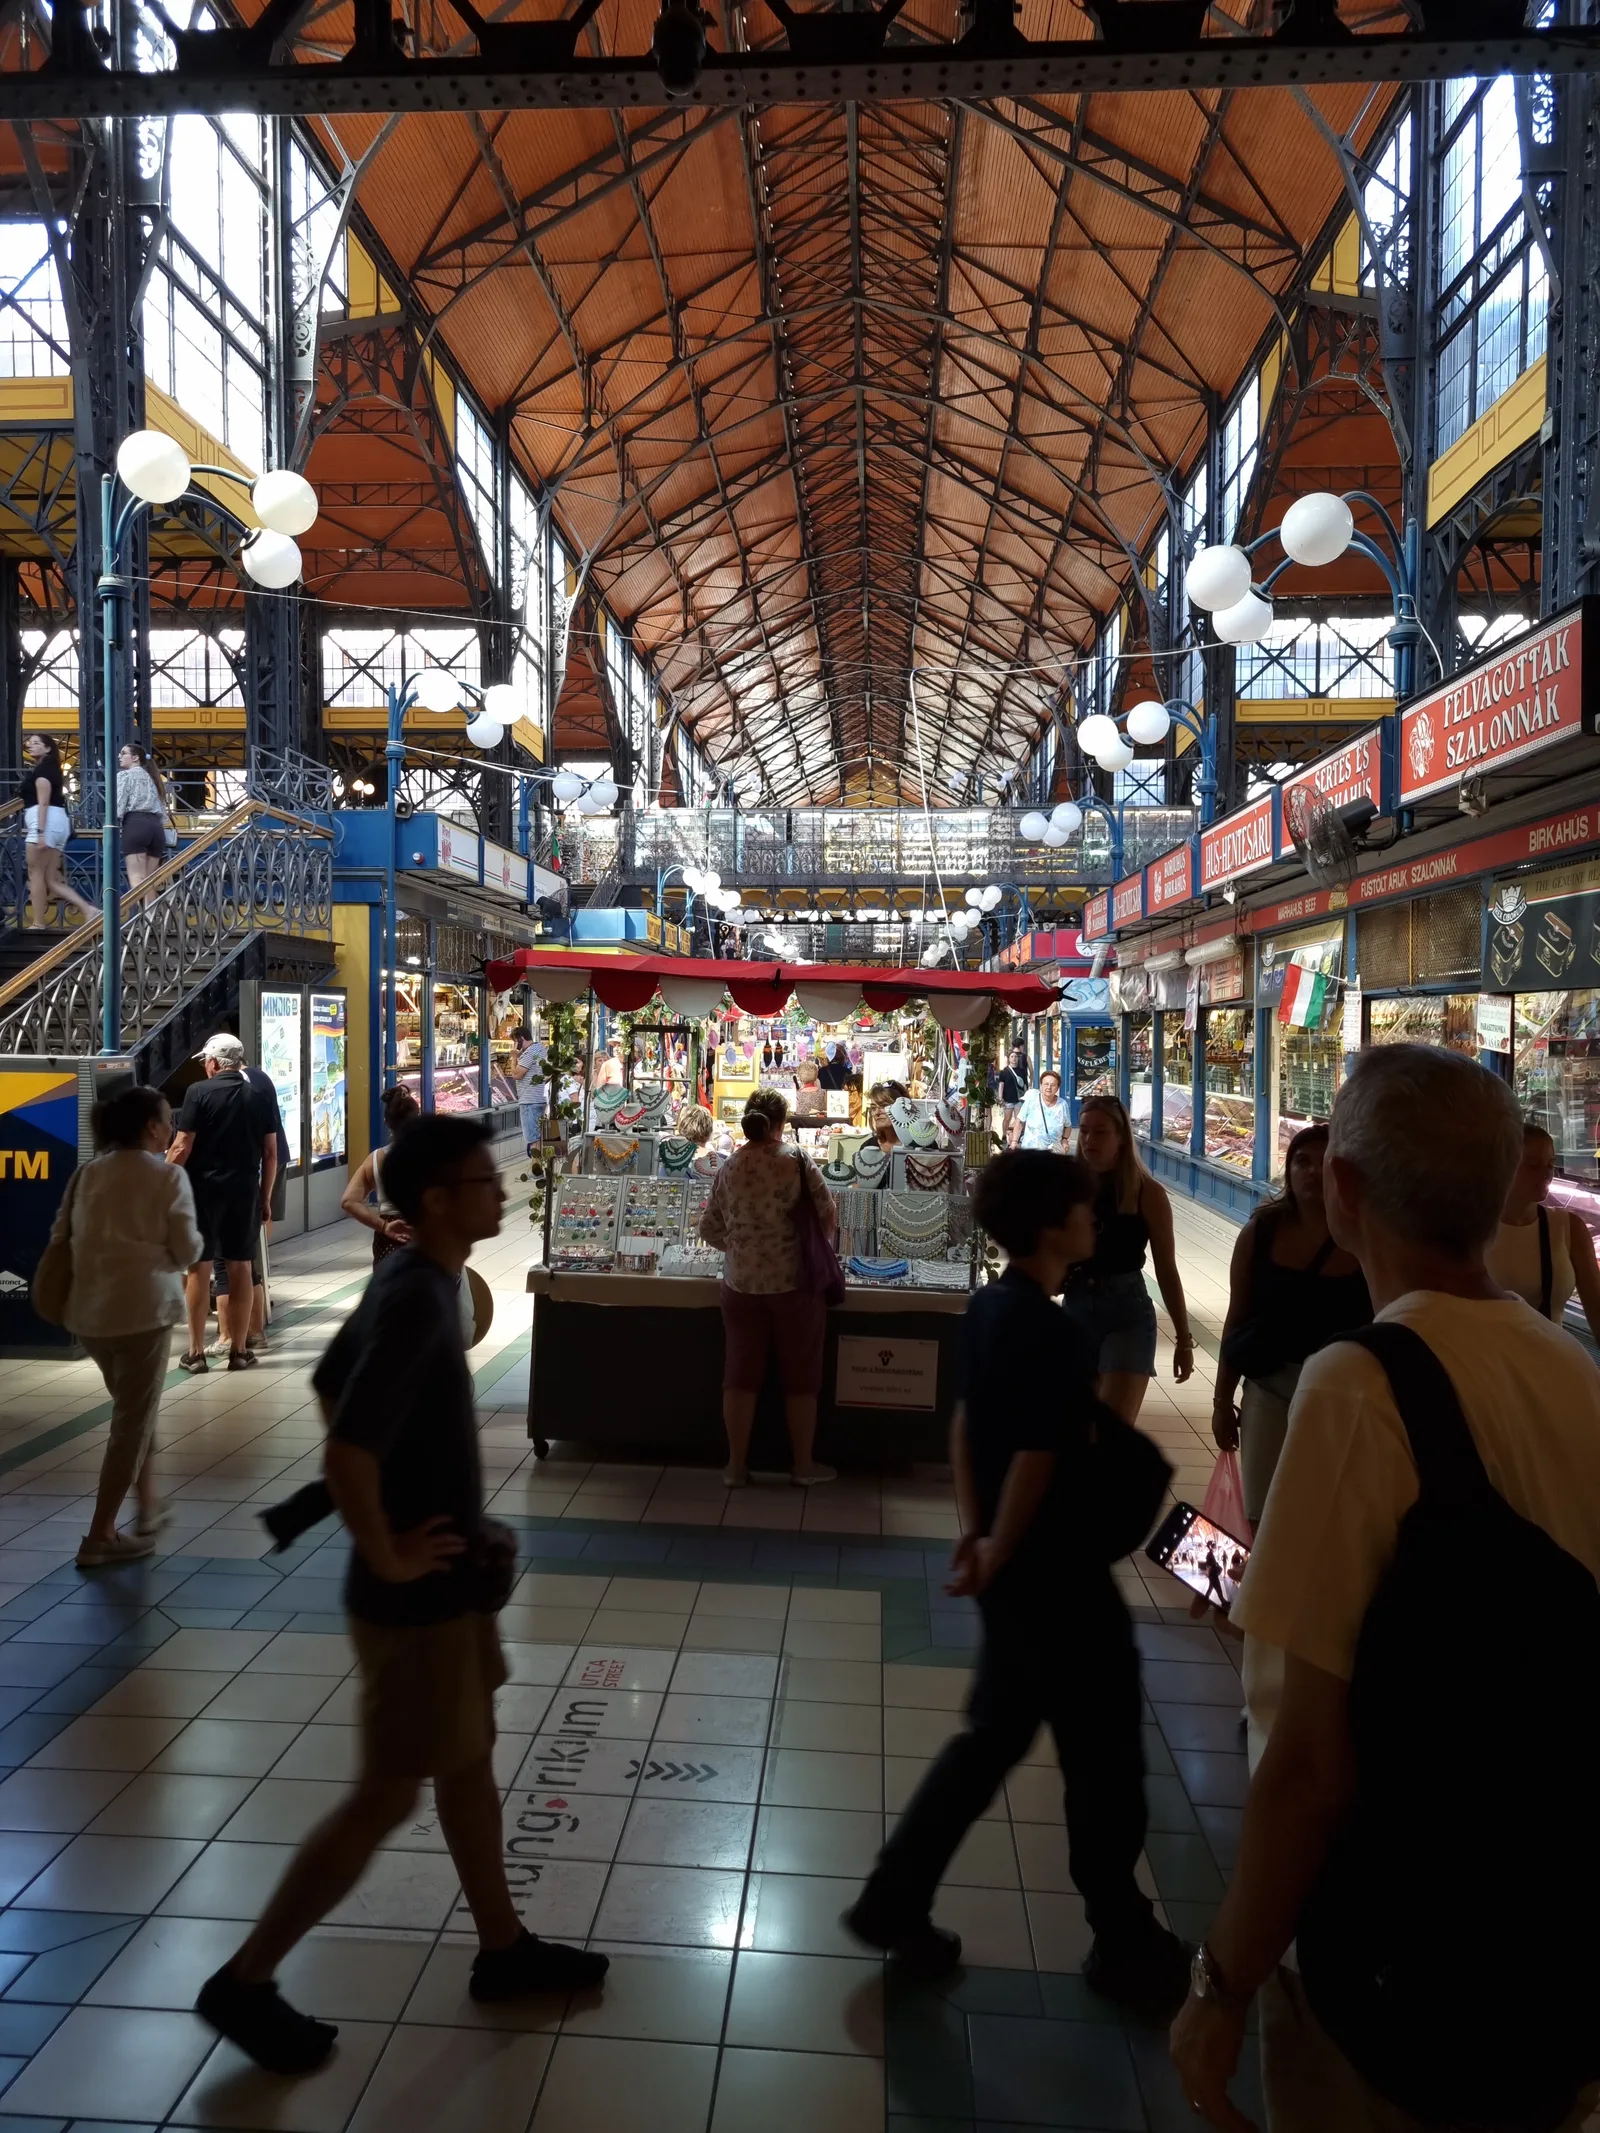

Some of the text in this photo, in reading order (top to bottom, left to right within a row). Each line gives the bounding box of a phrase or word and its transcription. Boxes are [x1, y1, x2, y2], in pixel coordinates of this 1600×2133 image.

[1443, 627, 1571, 730] FELVÁGOTTAK
[1445, 682, 1561, 770] SZALONNÁK
[1355, 739, 1370, 775] ÉS
[1411, 853, 1458, 884] SZALONNÁK
[1552, 871, 1585, 889] GENUINE
[262, 996, 291, 1017] MINDIG
[578, 1659, 608, 1686] UTCA
[602, 1659, 626, 1688] STREET
